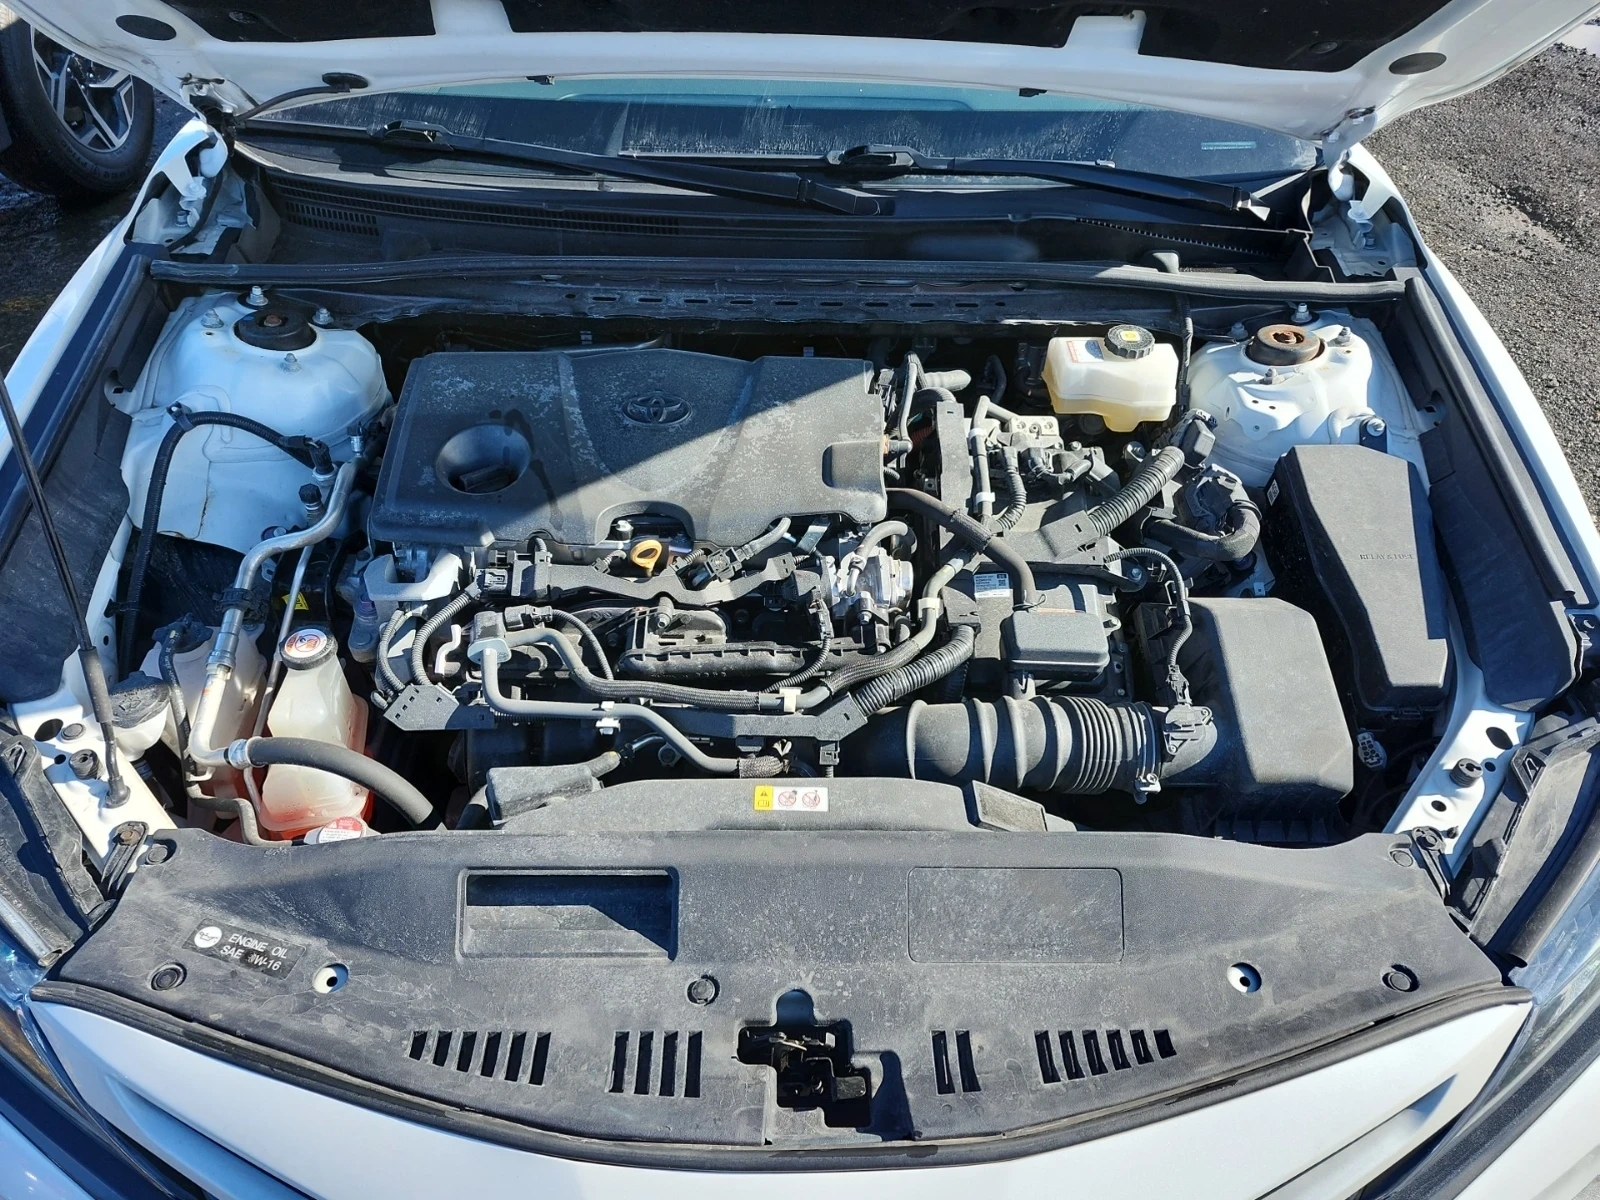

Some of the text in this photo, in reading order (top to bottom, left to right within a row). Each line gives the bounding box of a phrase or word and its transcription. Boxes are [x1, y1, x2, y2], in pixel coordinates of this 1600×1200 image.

[220, 945, 244, 959] SAE
[229, 933, 287, 959] ENGINE OIL
